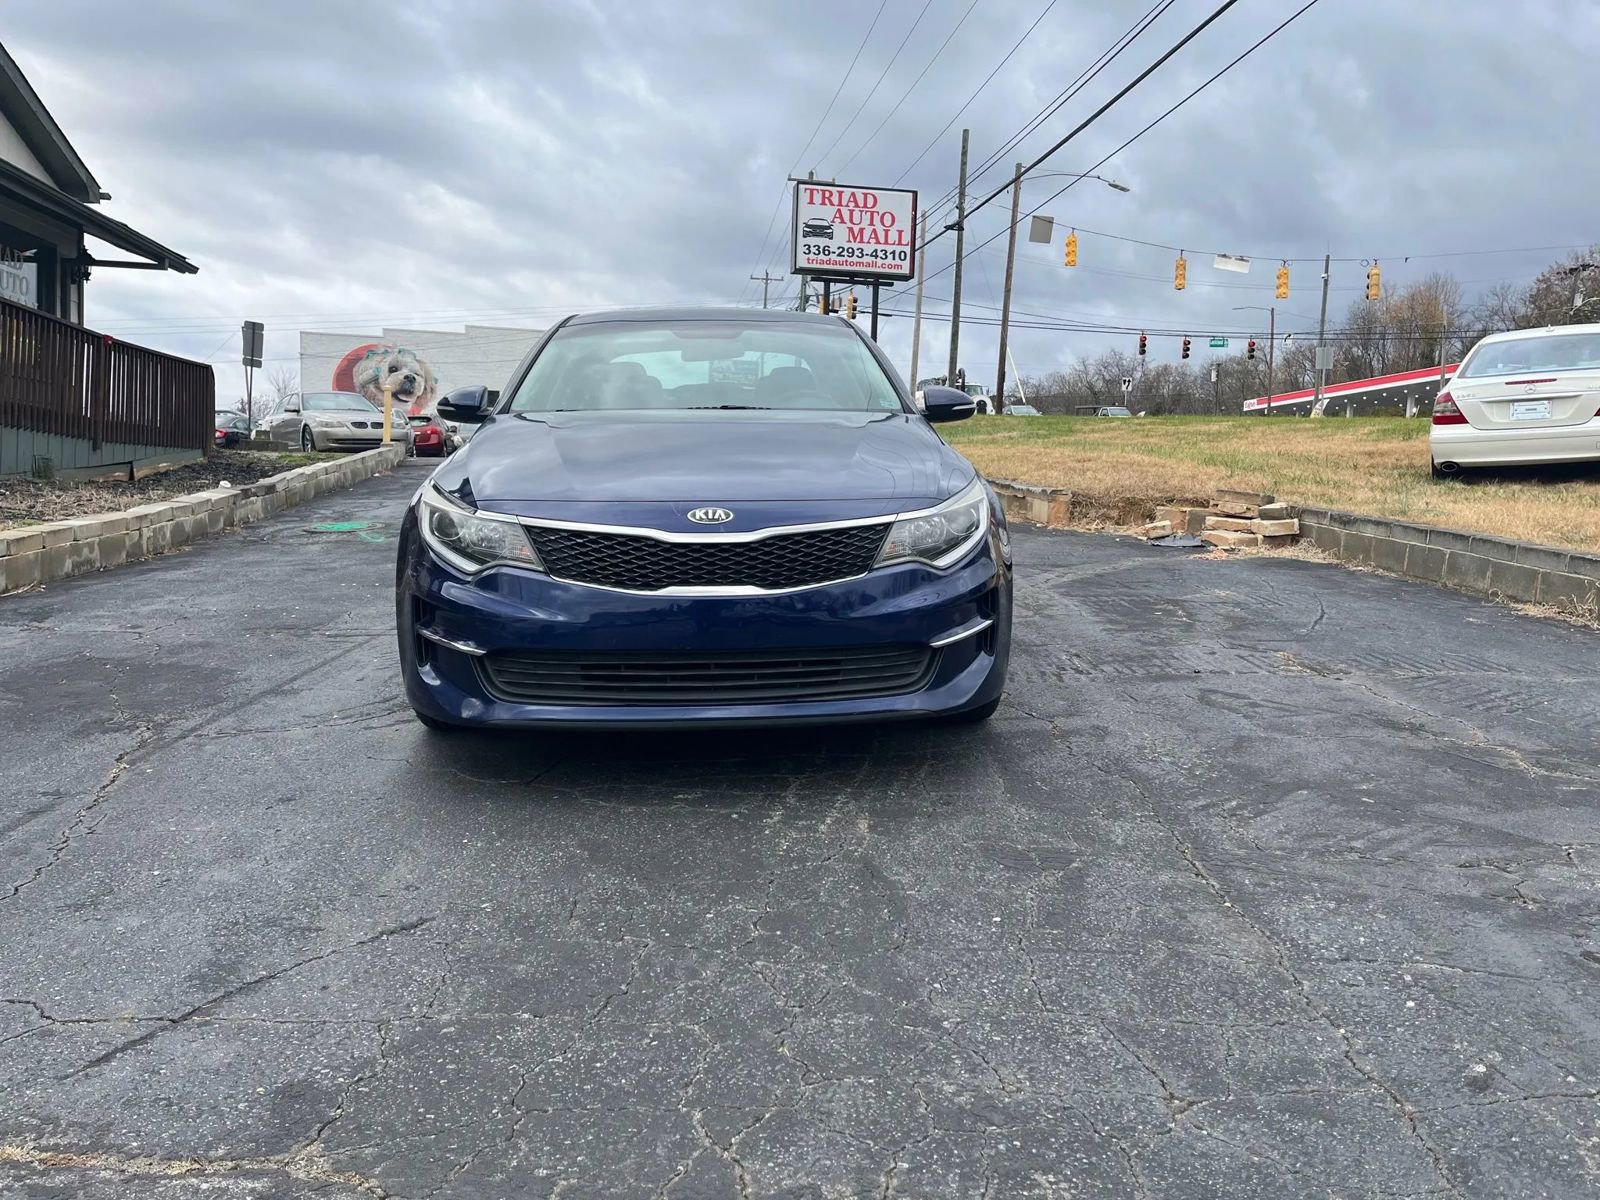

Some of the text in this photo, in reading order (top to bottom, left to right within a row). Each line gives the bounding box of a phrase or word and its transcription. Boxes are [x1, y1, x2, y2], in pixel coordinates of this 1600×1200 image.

[804, 187, 878, 209] TRIAD
[830, 207, 896, 228] AUTO
[846, 226, 910, 246] MALL
[802, 244, 907, 261] 336-293-4310
[806, 257, 903, 270] triadautomall.com
[694, 508, 727, 521] KIA
